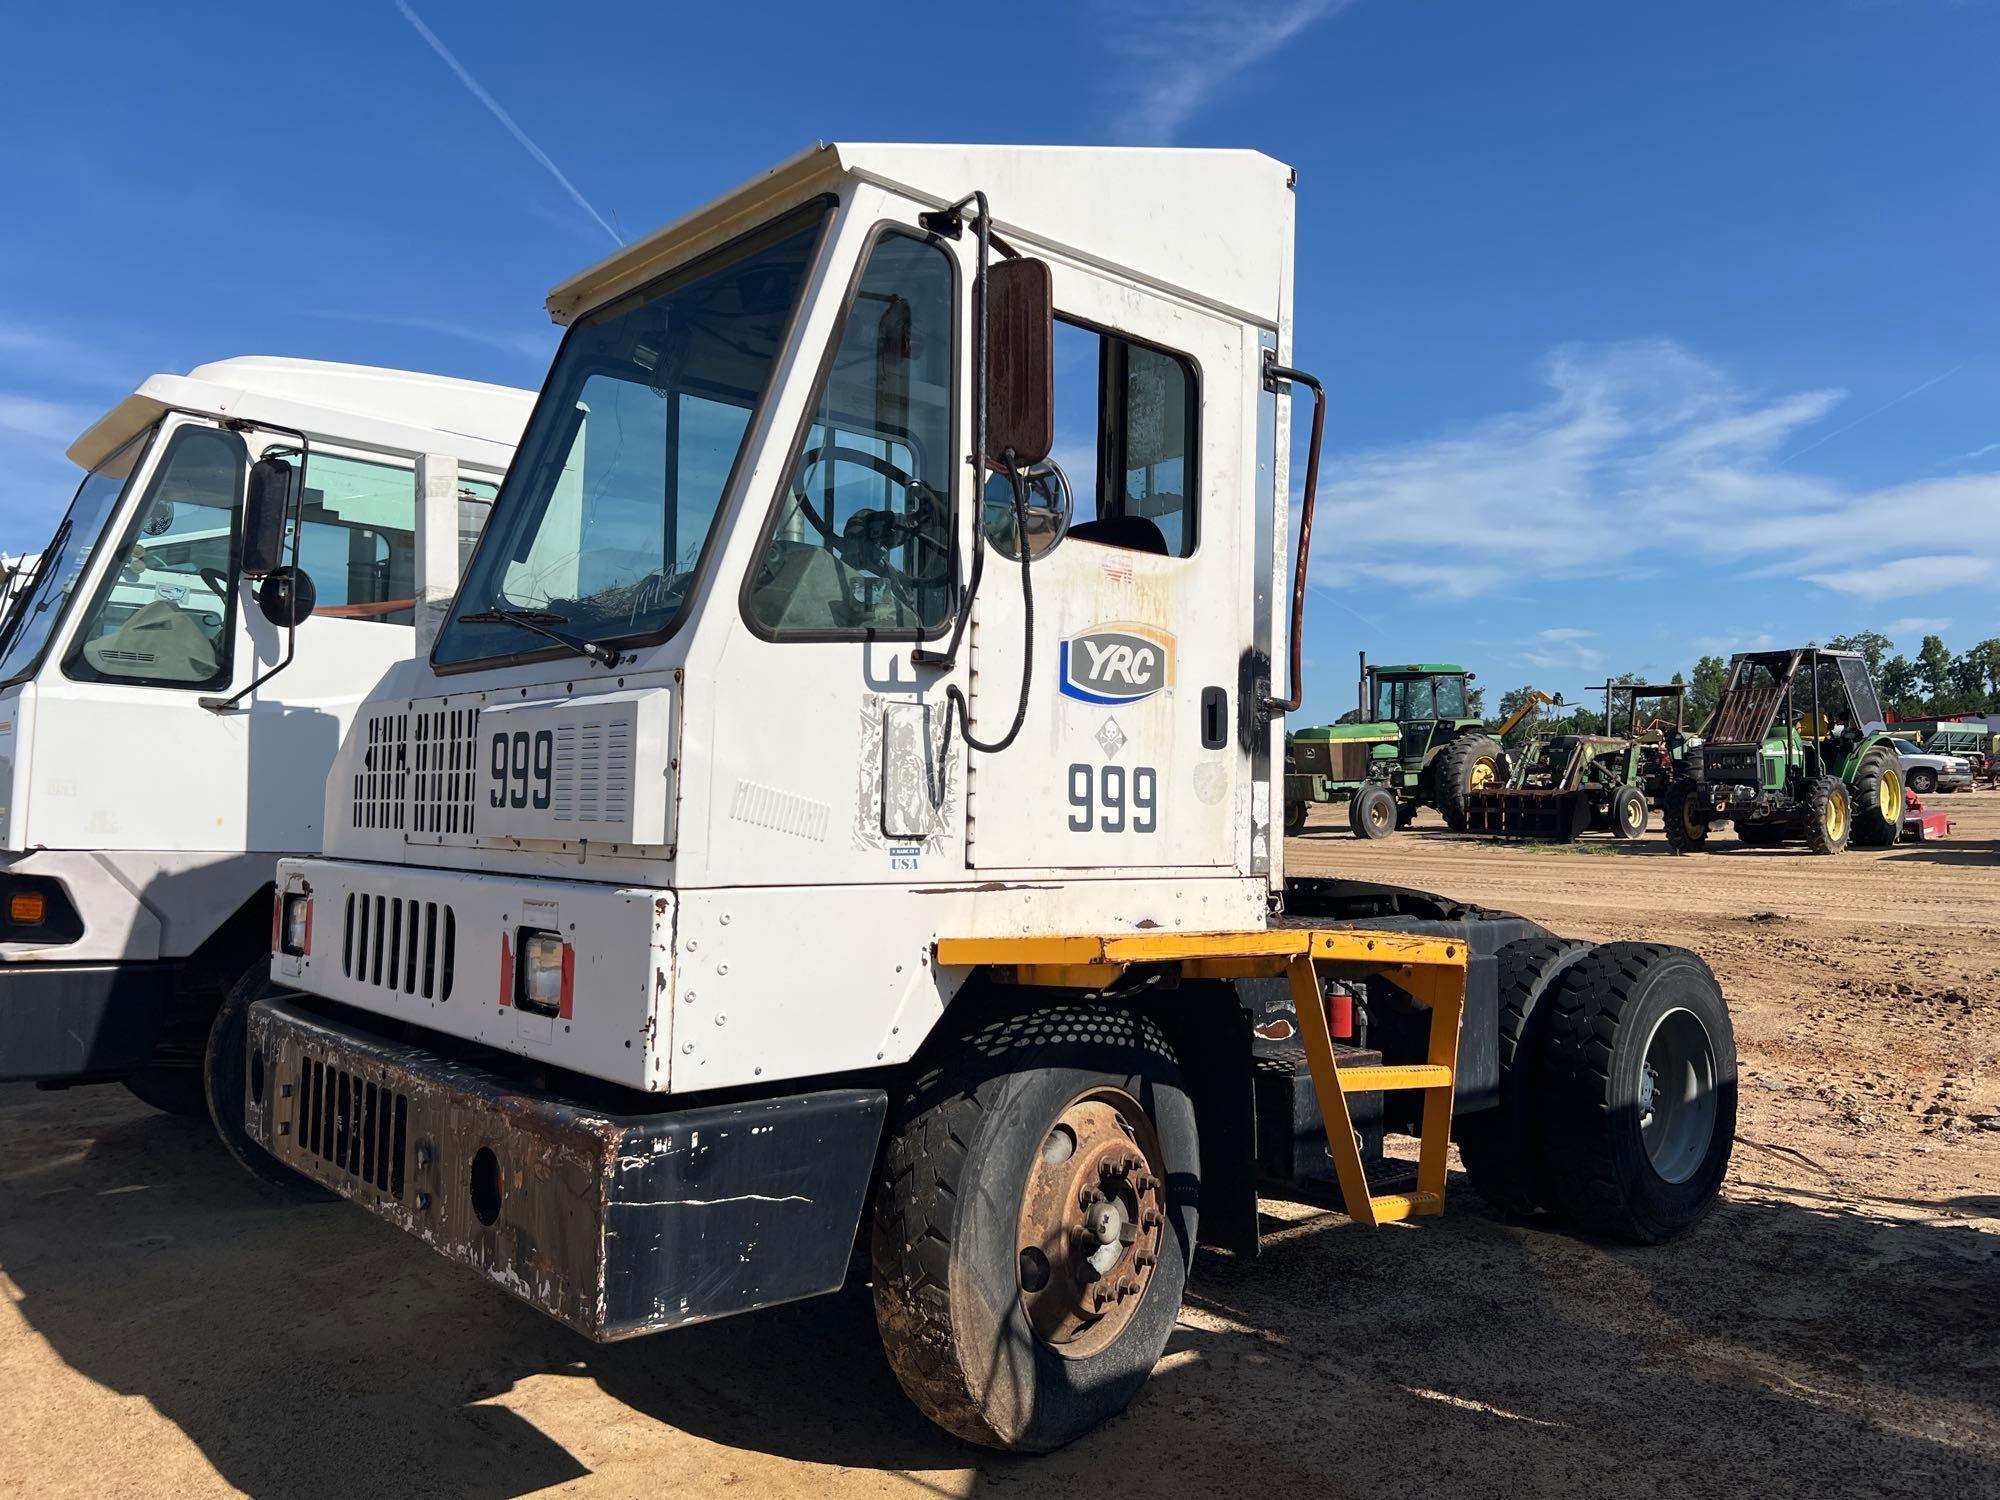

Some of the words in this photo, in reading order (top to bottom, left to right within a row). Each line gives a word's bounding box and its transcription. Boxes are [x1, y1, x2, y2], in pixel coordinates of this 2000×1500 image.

[1083, 640, 1155, 685] YRC
[490, 730, 553, 809] 999
[1068, 763, 1156, 832] 999
[891, 858, 918, 870] USA
